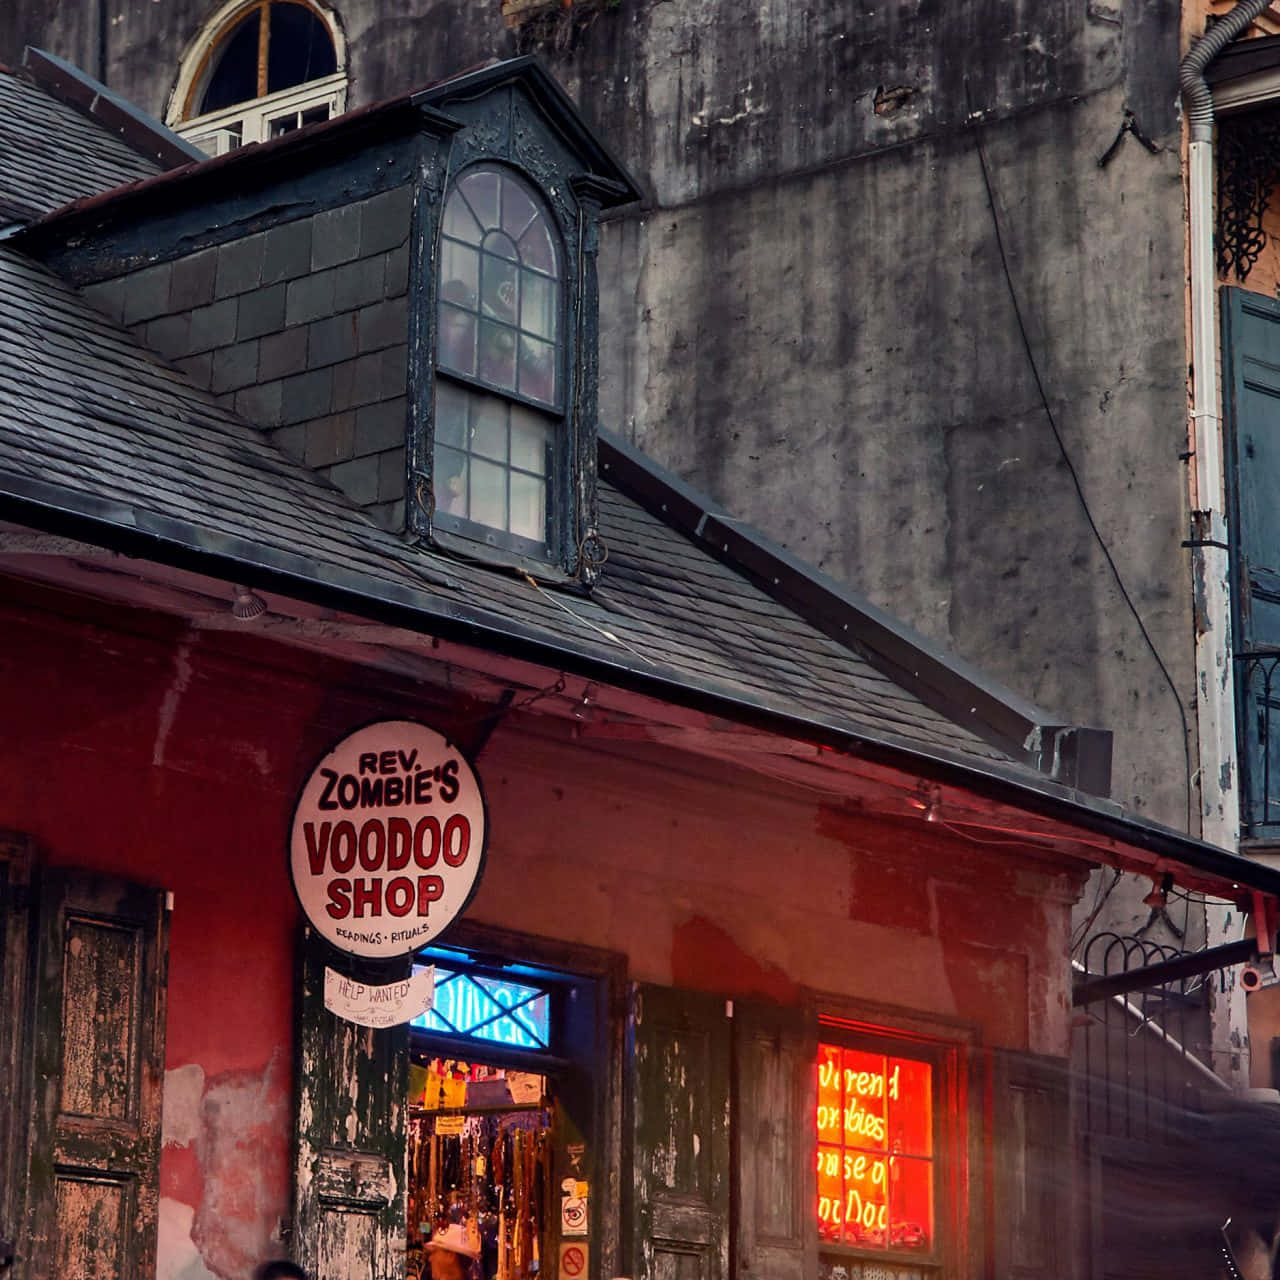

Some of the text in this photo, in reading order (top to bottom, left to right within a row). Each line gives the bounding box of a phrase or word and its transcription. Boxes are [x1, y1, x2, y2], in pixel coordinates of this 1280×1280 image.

[358, 749, 422, 775] REV.
[318, 759, 460, 811] ZOMBIE'S
[303, 813, 471, 876] VOODOO
[325, 874, 445, 919] SHOP
[336, 923, 429, 944] READINGS RITUALS
[338, 979, 409, 1003] HELP WANTED
